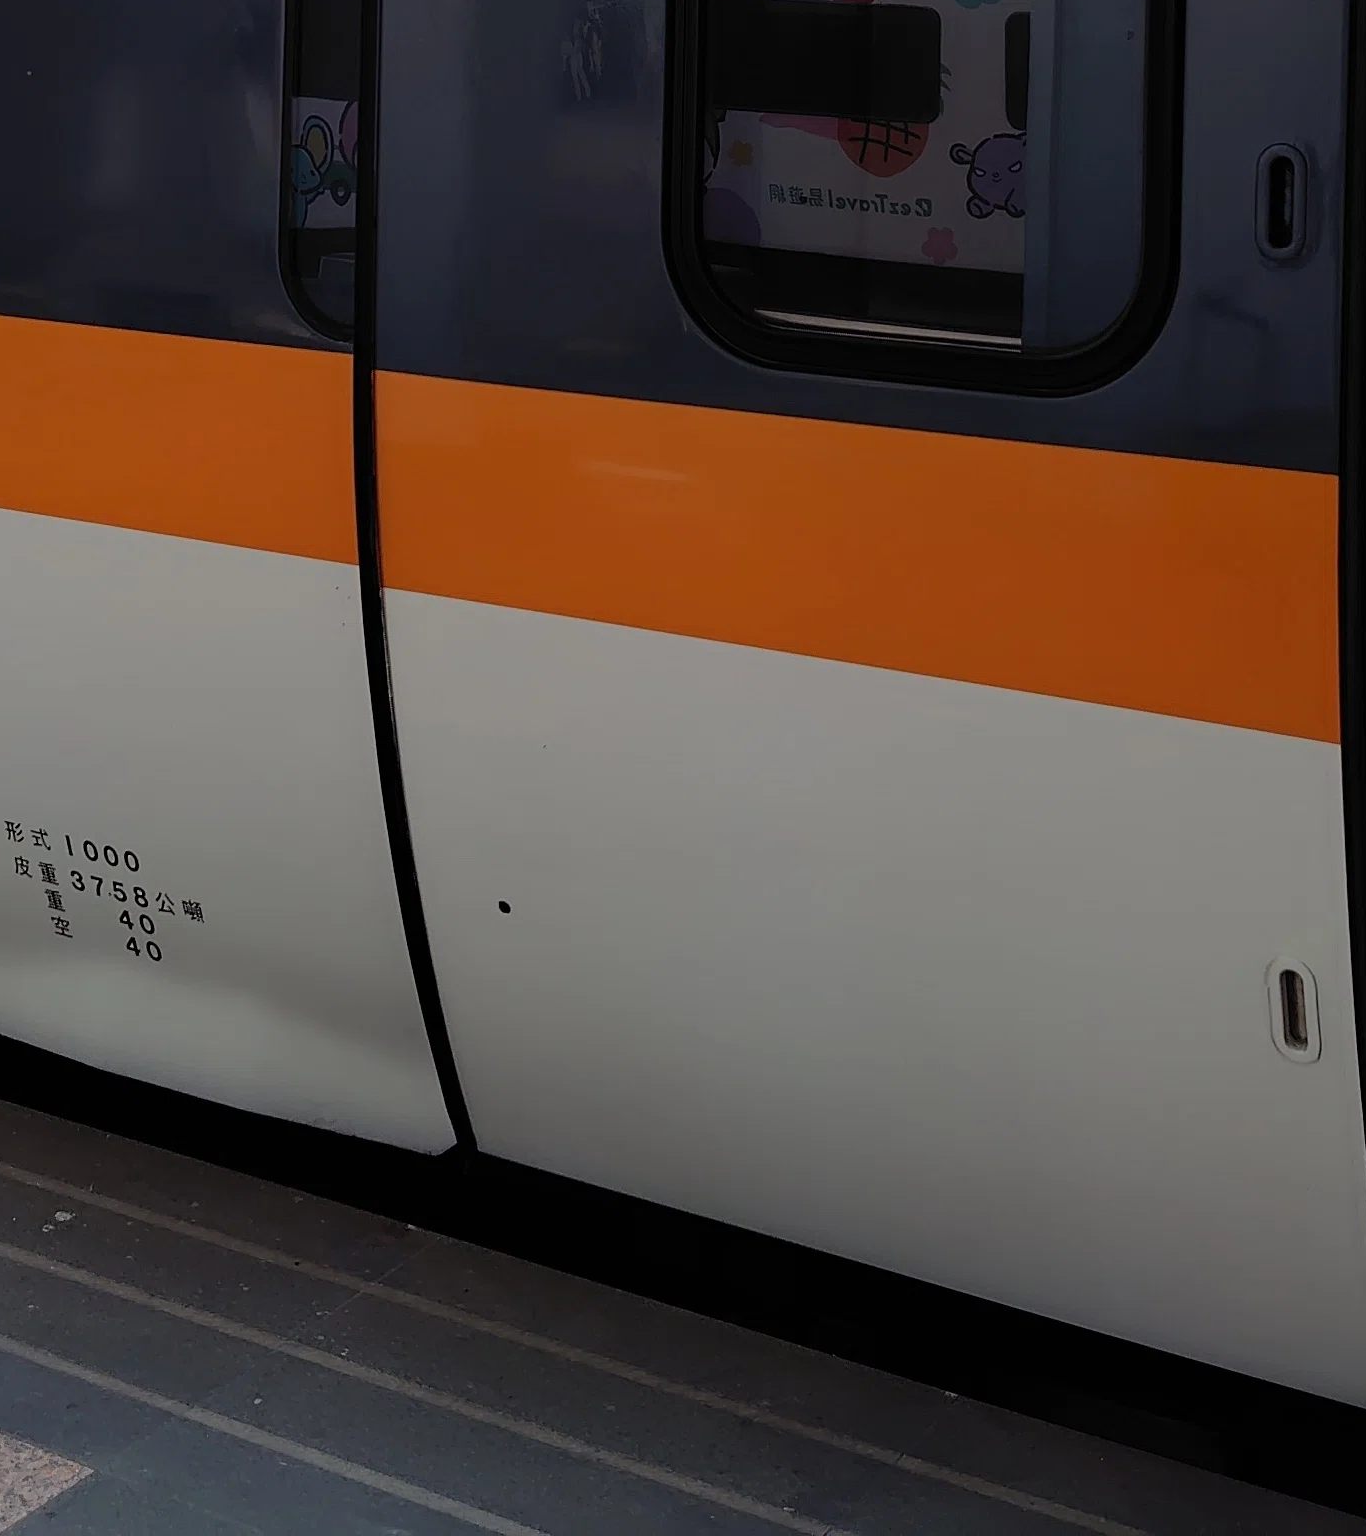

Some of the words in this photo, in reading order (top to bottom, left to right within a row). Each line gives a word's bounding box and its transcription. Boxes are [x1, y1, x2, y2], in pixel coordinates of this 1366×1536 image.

[4, 820, 51, 851] 形式
[64, 834, 140, 873] 1000
[14, 855, 60, 886] 皮重
[51, 916, 74, 939] 空
[126, 936, 162, 962] 40
[119, 910, 155, 935] 40
